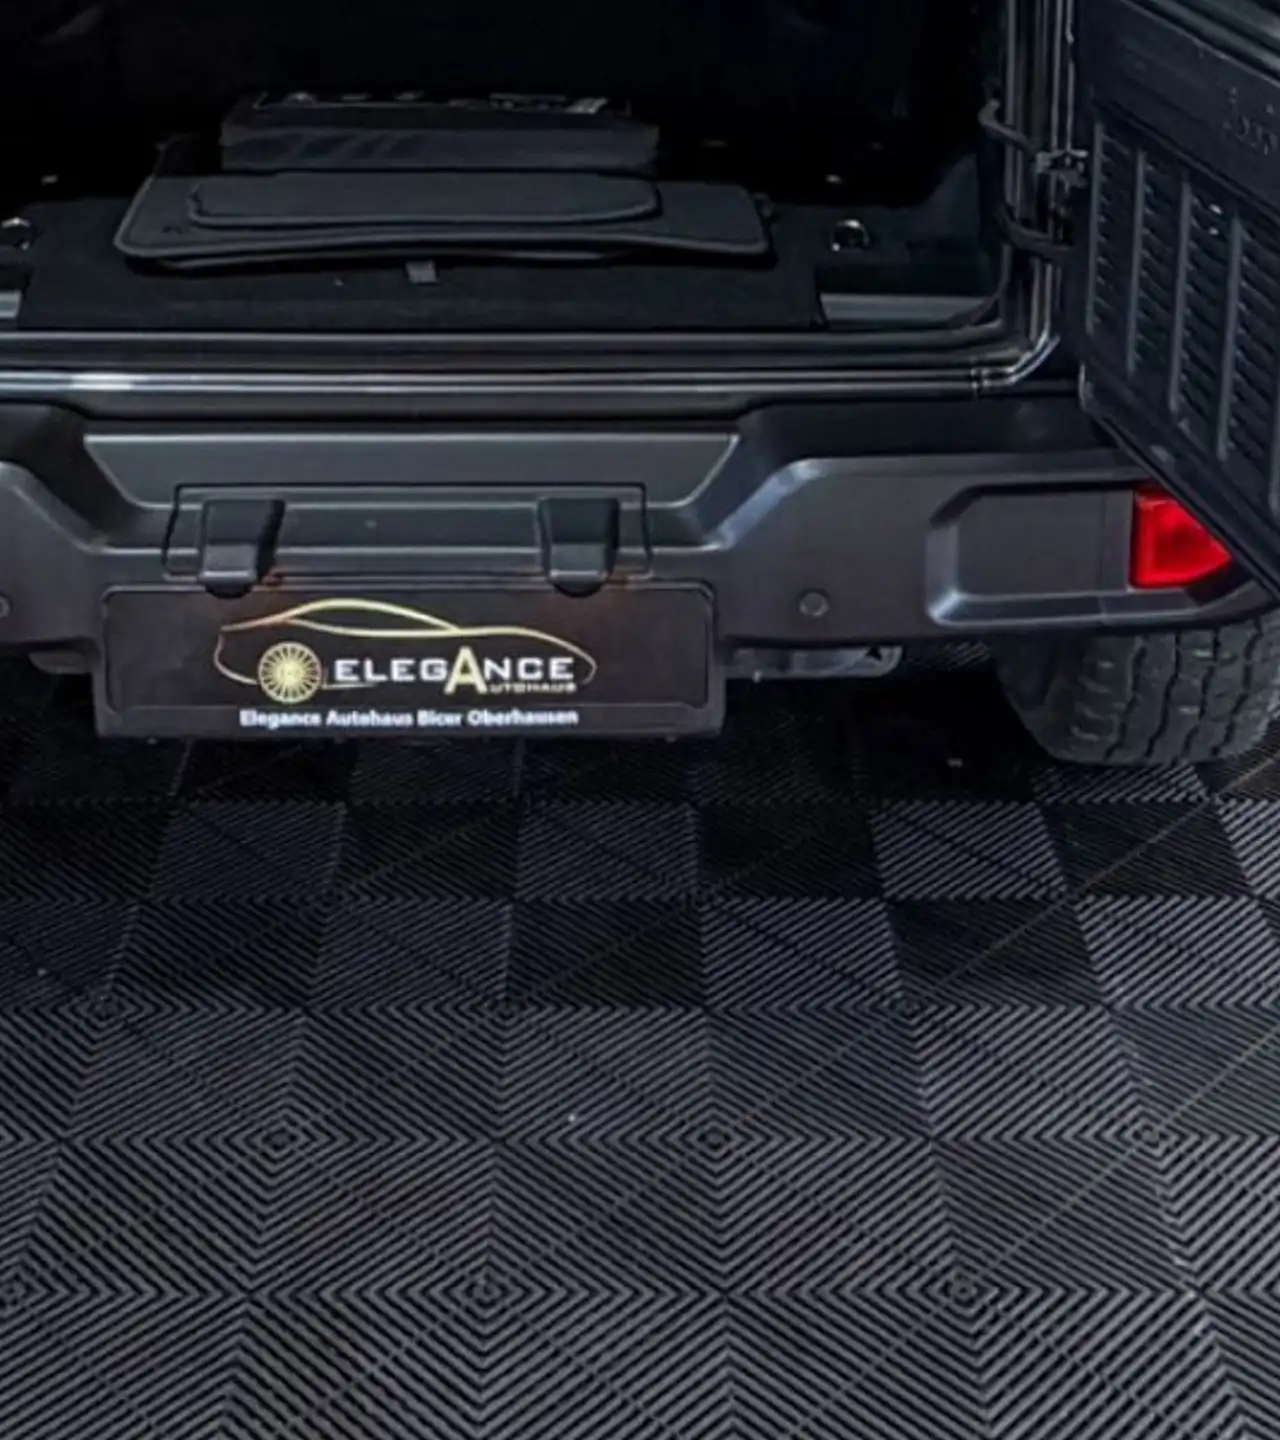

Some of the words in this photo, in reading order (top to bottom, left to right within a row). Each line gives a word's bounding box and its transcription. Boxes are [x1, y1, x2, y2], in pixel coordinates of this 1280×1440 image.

[333, 645, 576, 694] ELEGANCE
[238, 709, 322, 730] Elegance
[325, 709, 412, 727] Autohaus
[467, 709, 580, 728] Oberhausen
